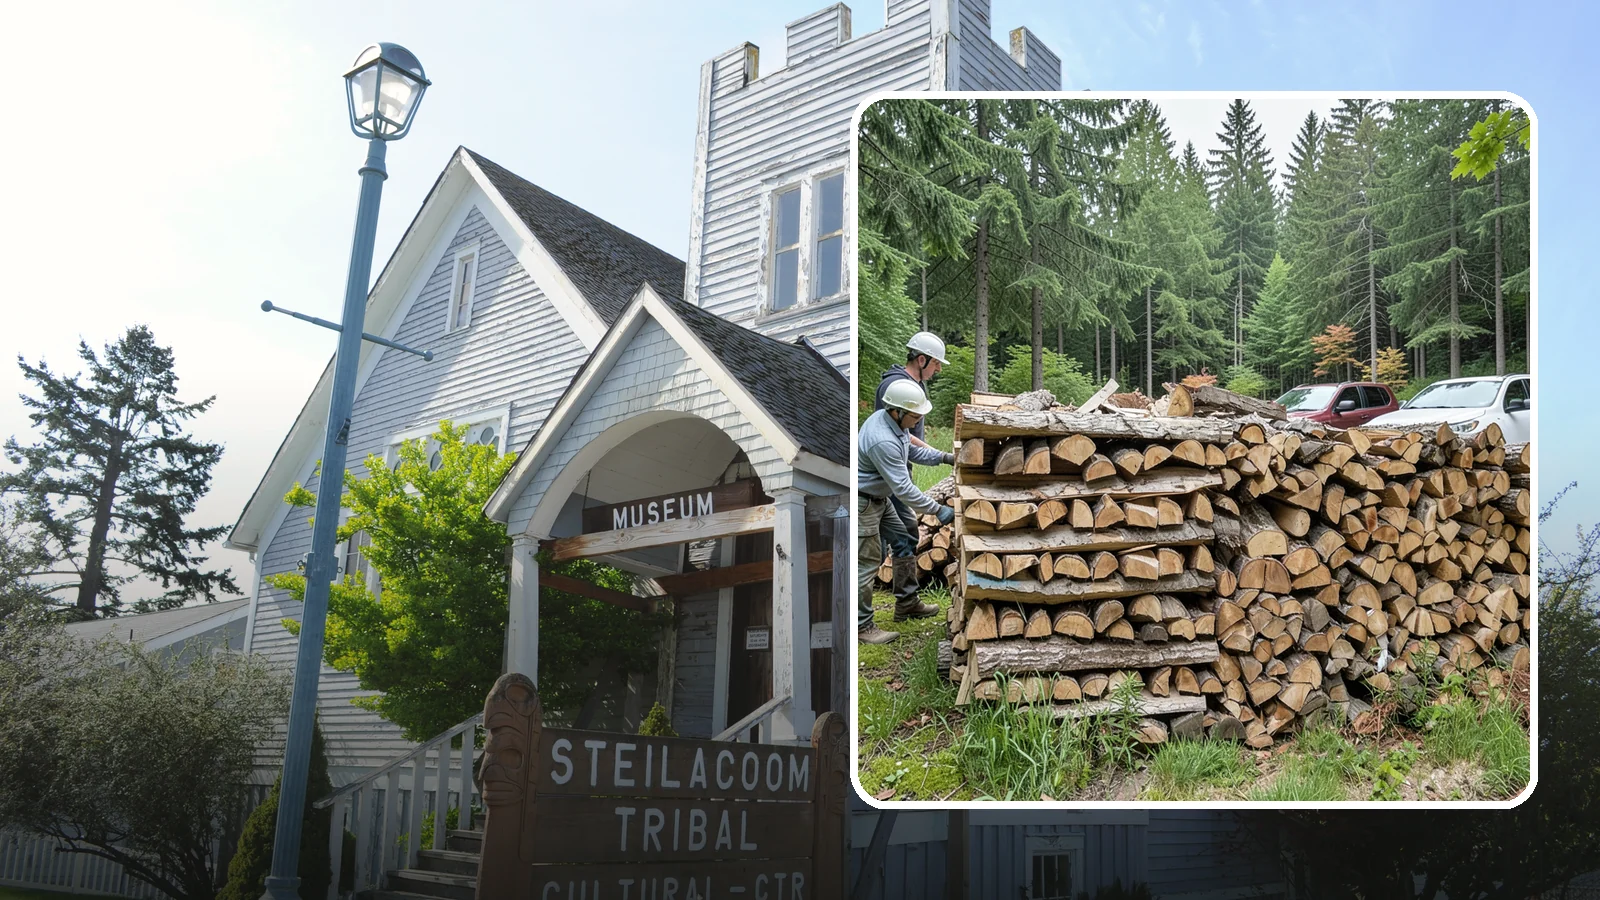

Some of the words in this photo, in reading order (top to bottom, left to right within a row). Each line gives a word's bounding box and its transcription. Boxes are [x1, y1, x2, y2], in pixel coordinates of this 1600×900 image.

[612, 491, 714, 531] MUSEUM
[550, 738, 809, 792] STEILACOOM
[615, 806, 757, 851] TRIBAL
